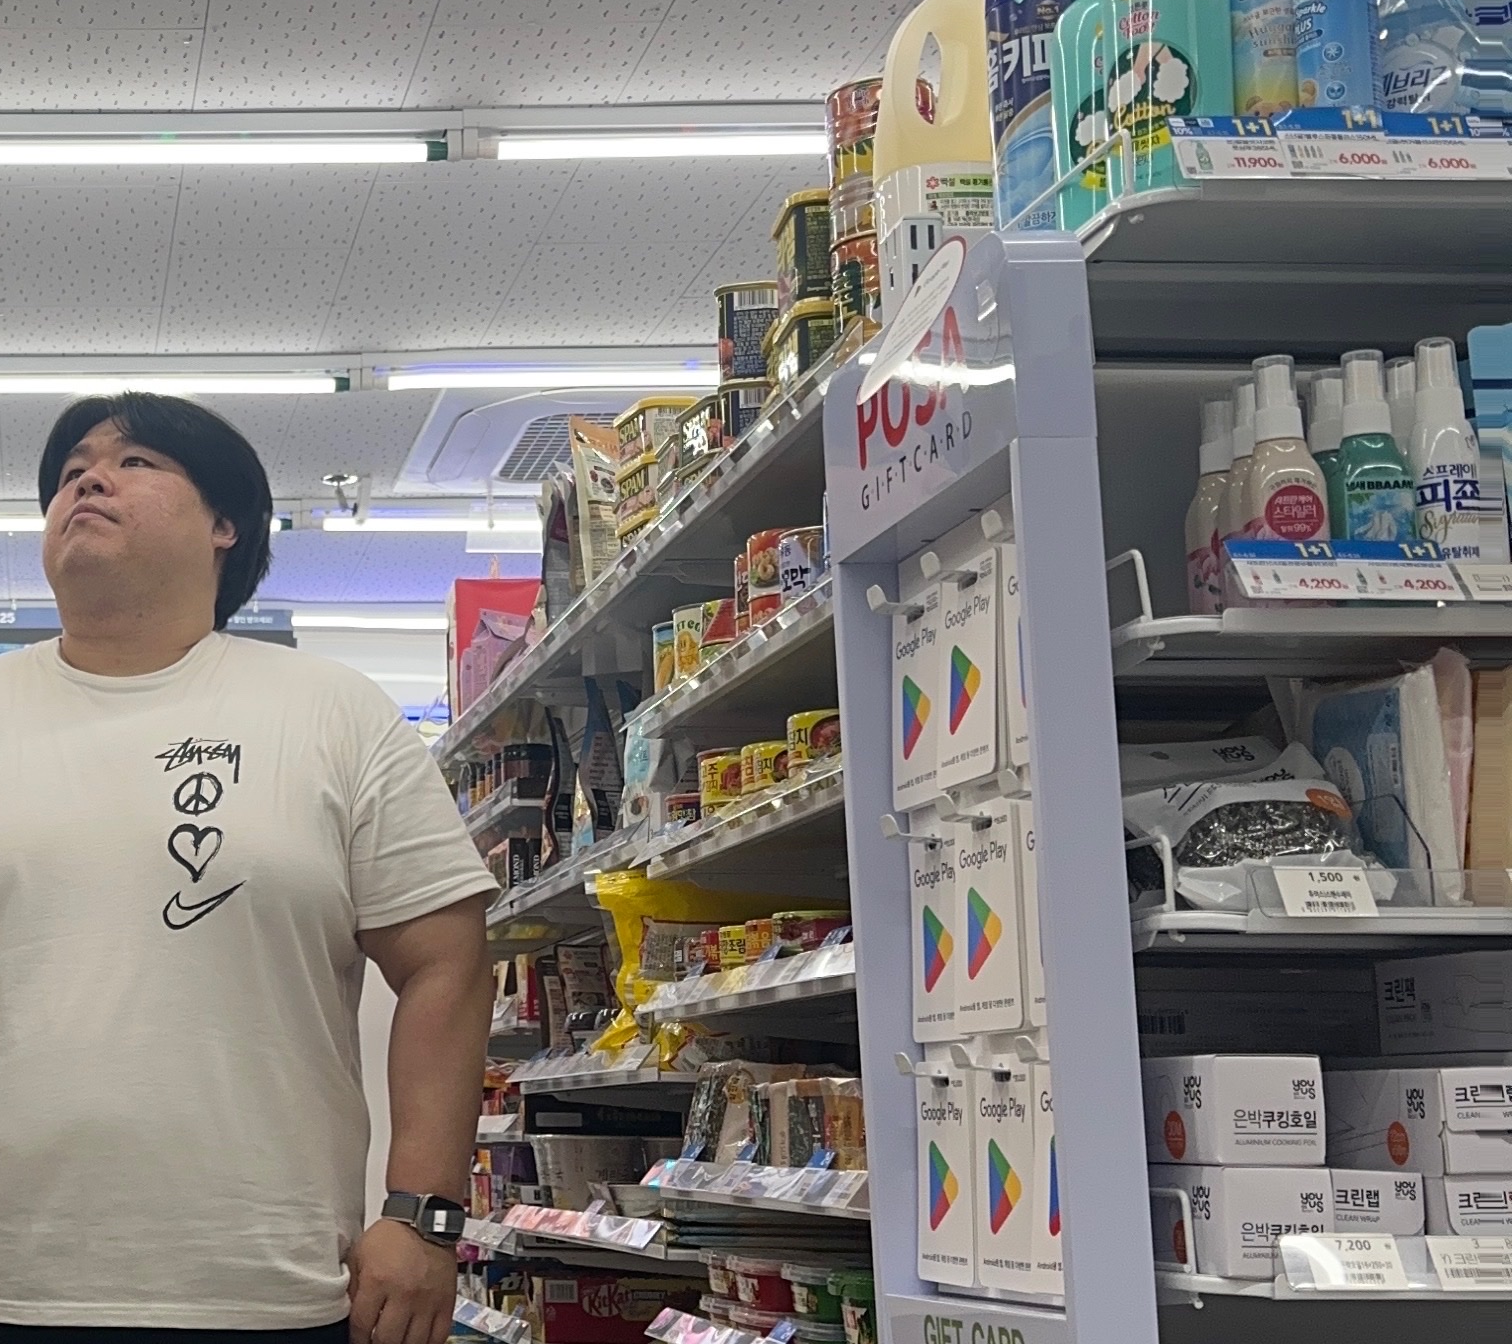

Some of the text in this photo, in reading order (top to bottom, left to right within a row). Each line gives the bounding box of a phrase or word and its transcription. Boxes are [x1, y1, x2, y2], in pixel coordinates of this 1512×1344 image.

[1233, 118, 1271, 135] 1+1
[1427, 117, 1463, 134] 1+1
[621, 467, 645, 501] SPAM
[1294, 543, 1333, 558] 1+1
[1399, 543, 1439, 558] 1+1
[944, 594, 991, 631] Google Play
[895, 625, 937, 661] Google Play
[959, 840, 1007, 870] Google Play
[914, 867, 938, 889] Google
[1308, 872, 1343, 883] 1,500
[921, 1102, 963, 1126] Google Play
[980, 1097, 1026, 1123] Google Play
[1233, 1110, 1317, 1129] 은박쿠킹호일
[1336, 1188, 1380, 1208] 크린랩
[588, 1285, 631, 1316] KitKat
